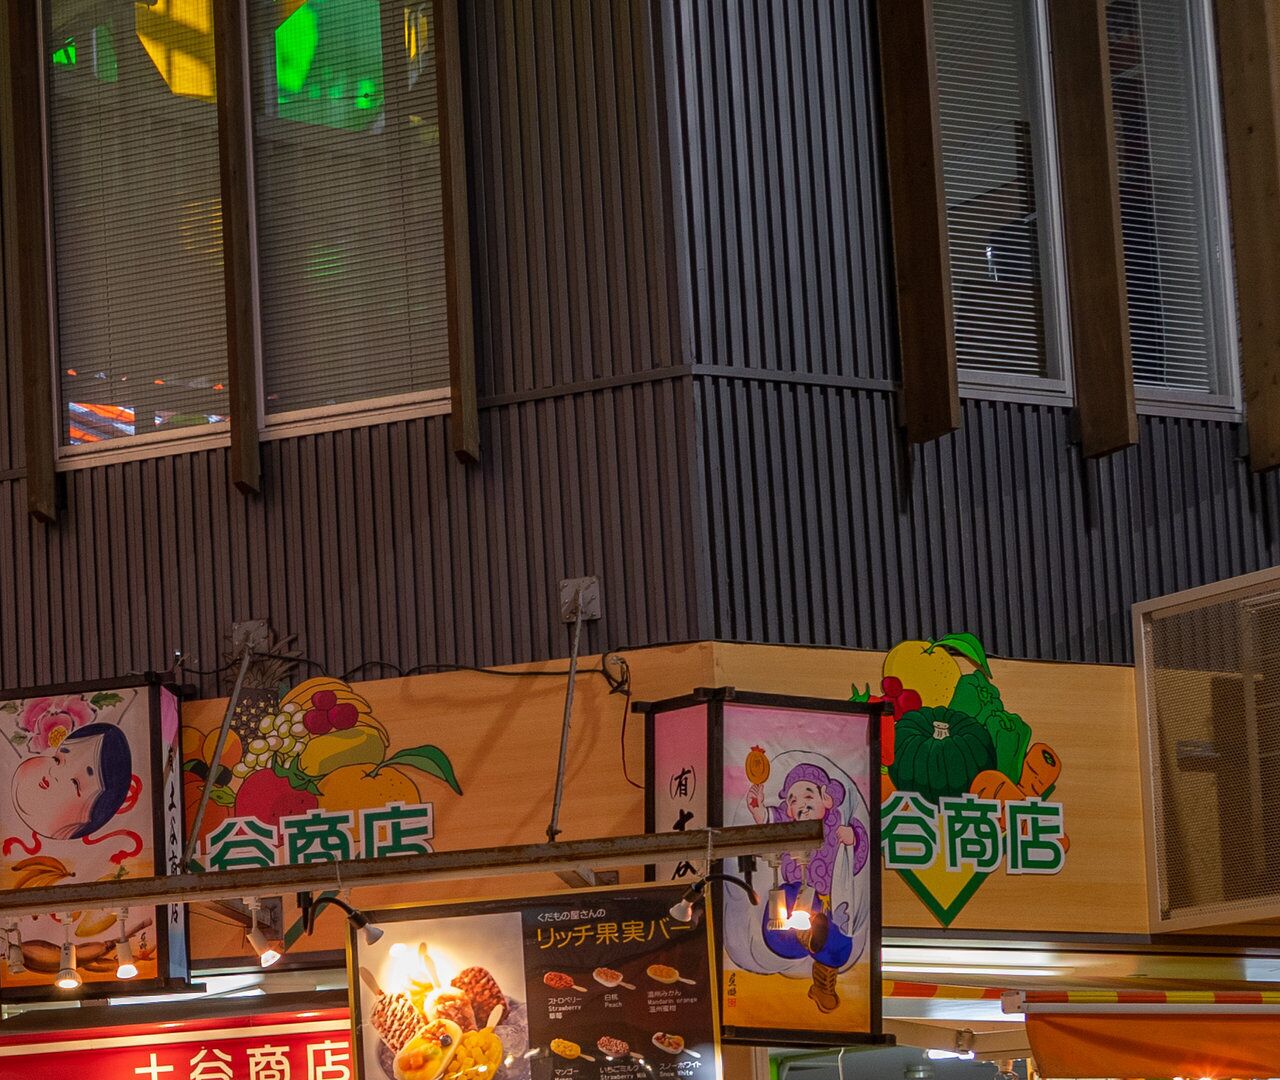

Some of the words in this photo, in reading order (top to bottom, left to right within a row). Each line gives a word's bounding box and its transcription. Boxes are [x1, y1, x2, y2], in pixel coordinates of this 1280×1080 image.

[537, 908, 606, 922] くだもの屋さんの
[537, 918, 690, 950] リッチ果実バー
[554, 1068, 579, 1076] マンゴー
[599, 1065, 639, 1074] いちごミルク
